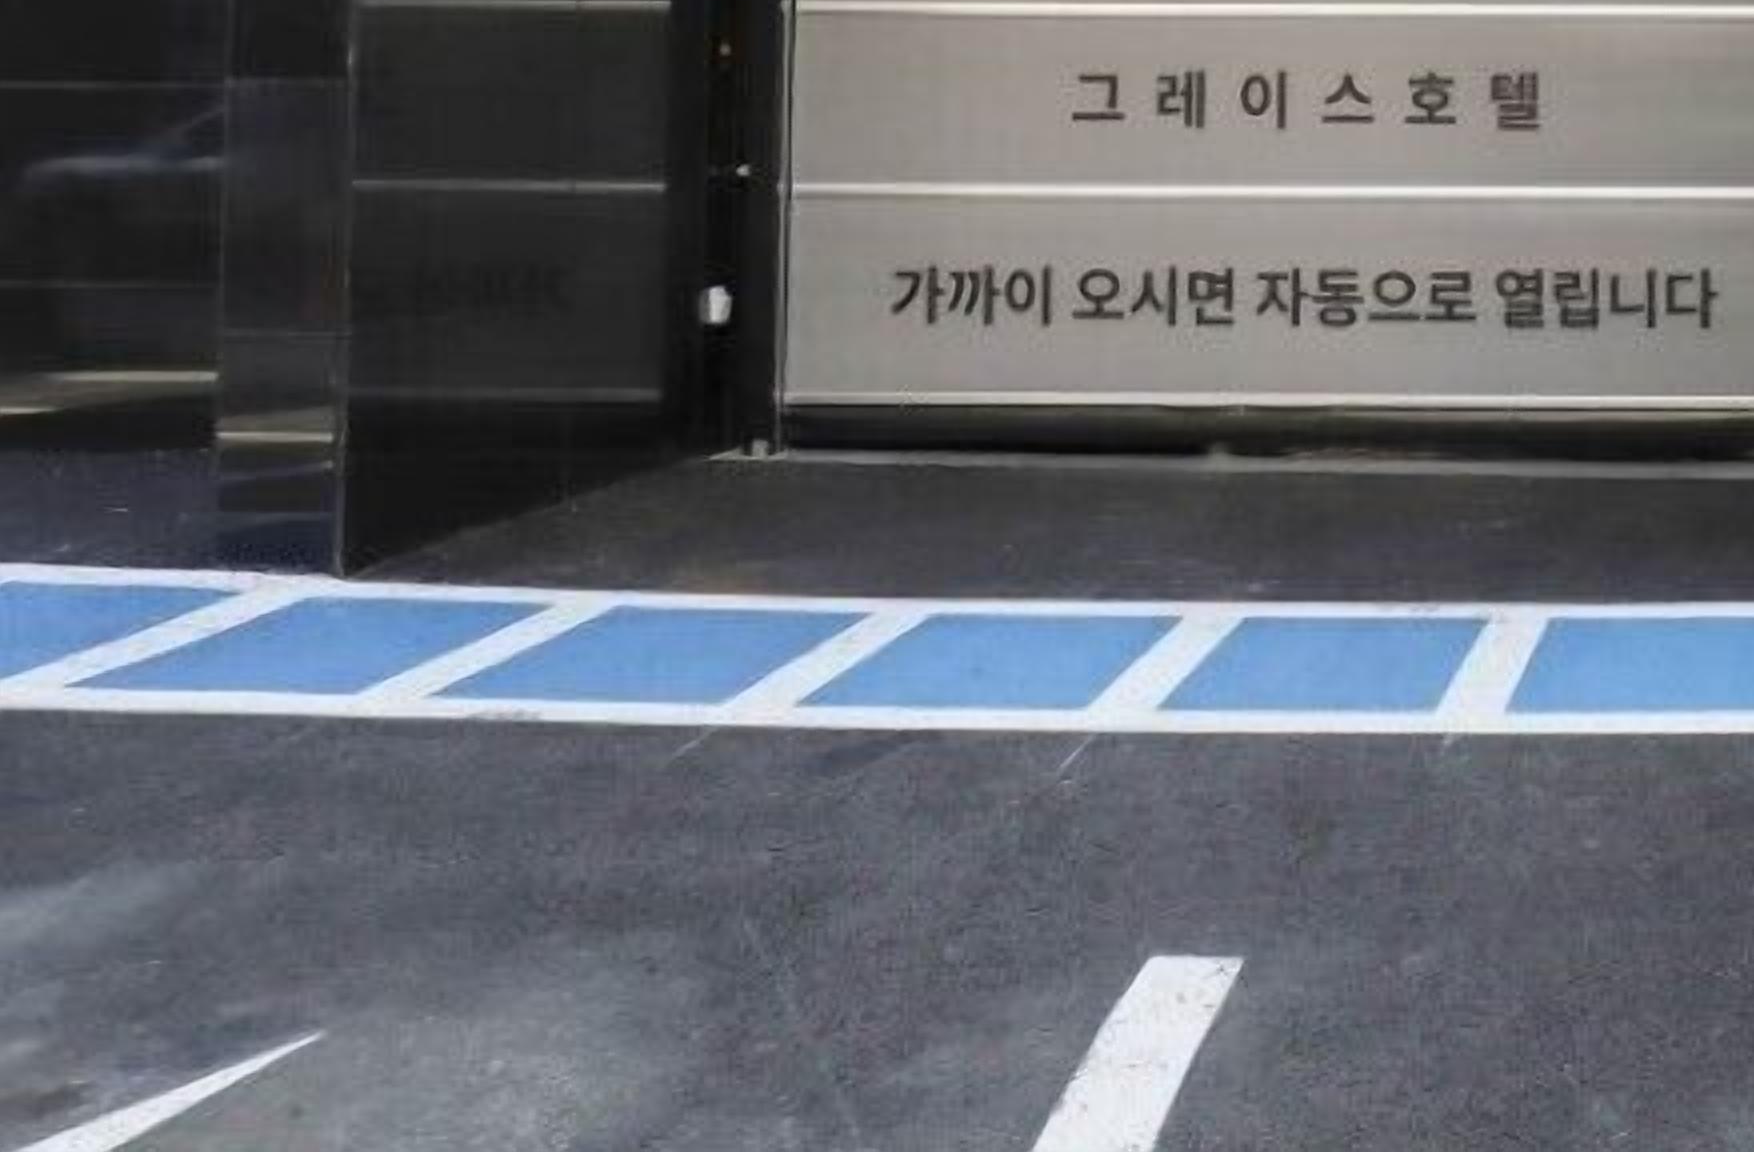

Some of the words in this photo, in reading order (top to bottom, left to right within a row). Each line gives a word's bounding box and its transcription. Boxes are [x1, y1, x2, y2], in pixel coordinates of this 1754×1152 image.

[891, 265, 1052, 327] 가까이
[1072, 268, 1235, 327] 오시면
[1255, 268, 1478, 328] 자동으로
[1494, 268, 1720, 329] 열립니다
